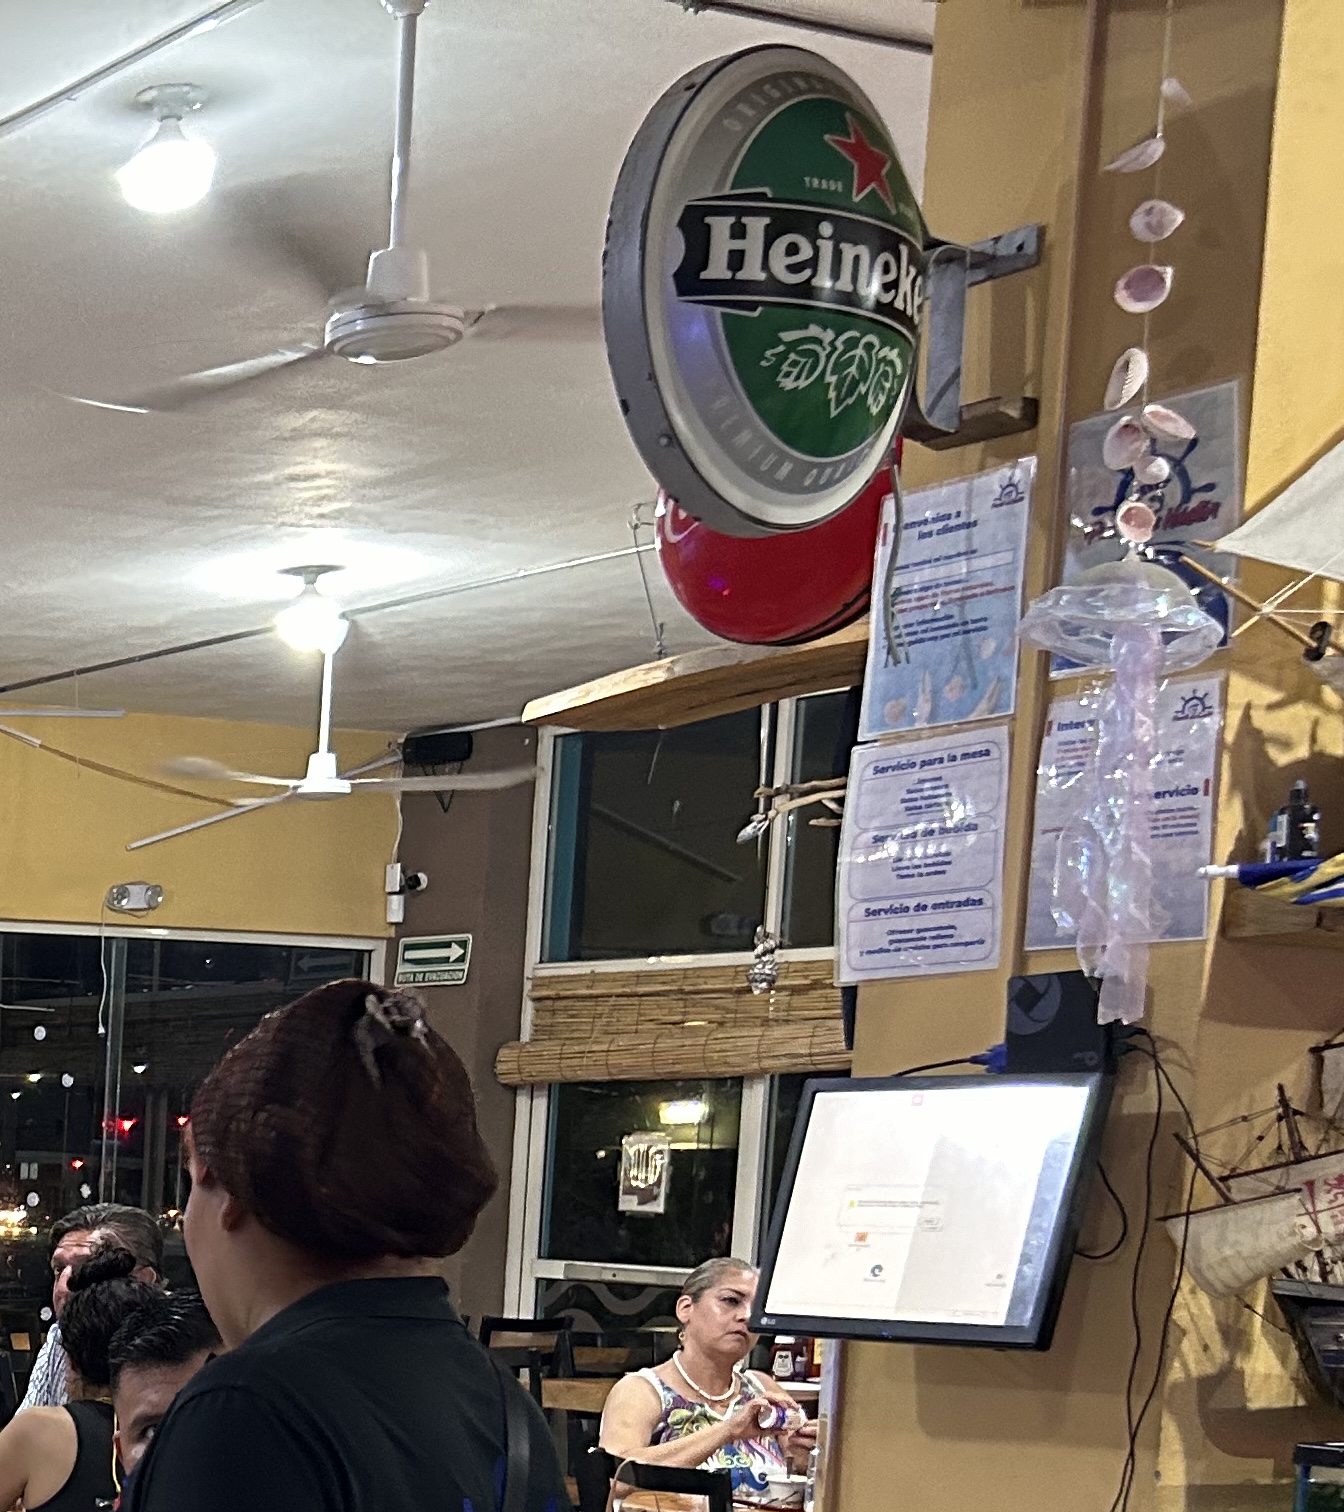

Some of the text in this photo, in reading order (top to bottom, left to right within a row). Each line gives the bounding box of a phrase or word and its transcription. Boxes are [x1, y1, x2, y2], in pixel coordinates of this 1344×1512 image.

[699, 215, 926, 326] Heineke
[872, 748, 991, 776] Servicio para la mesa
[1153, 783, 1200, 800] ervicio
[864, 897, 984, 918] Servicio de entradas
